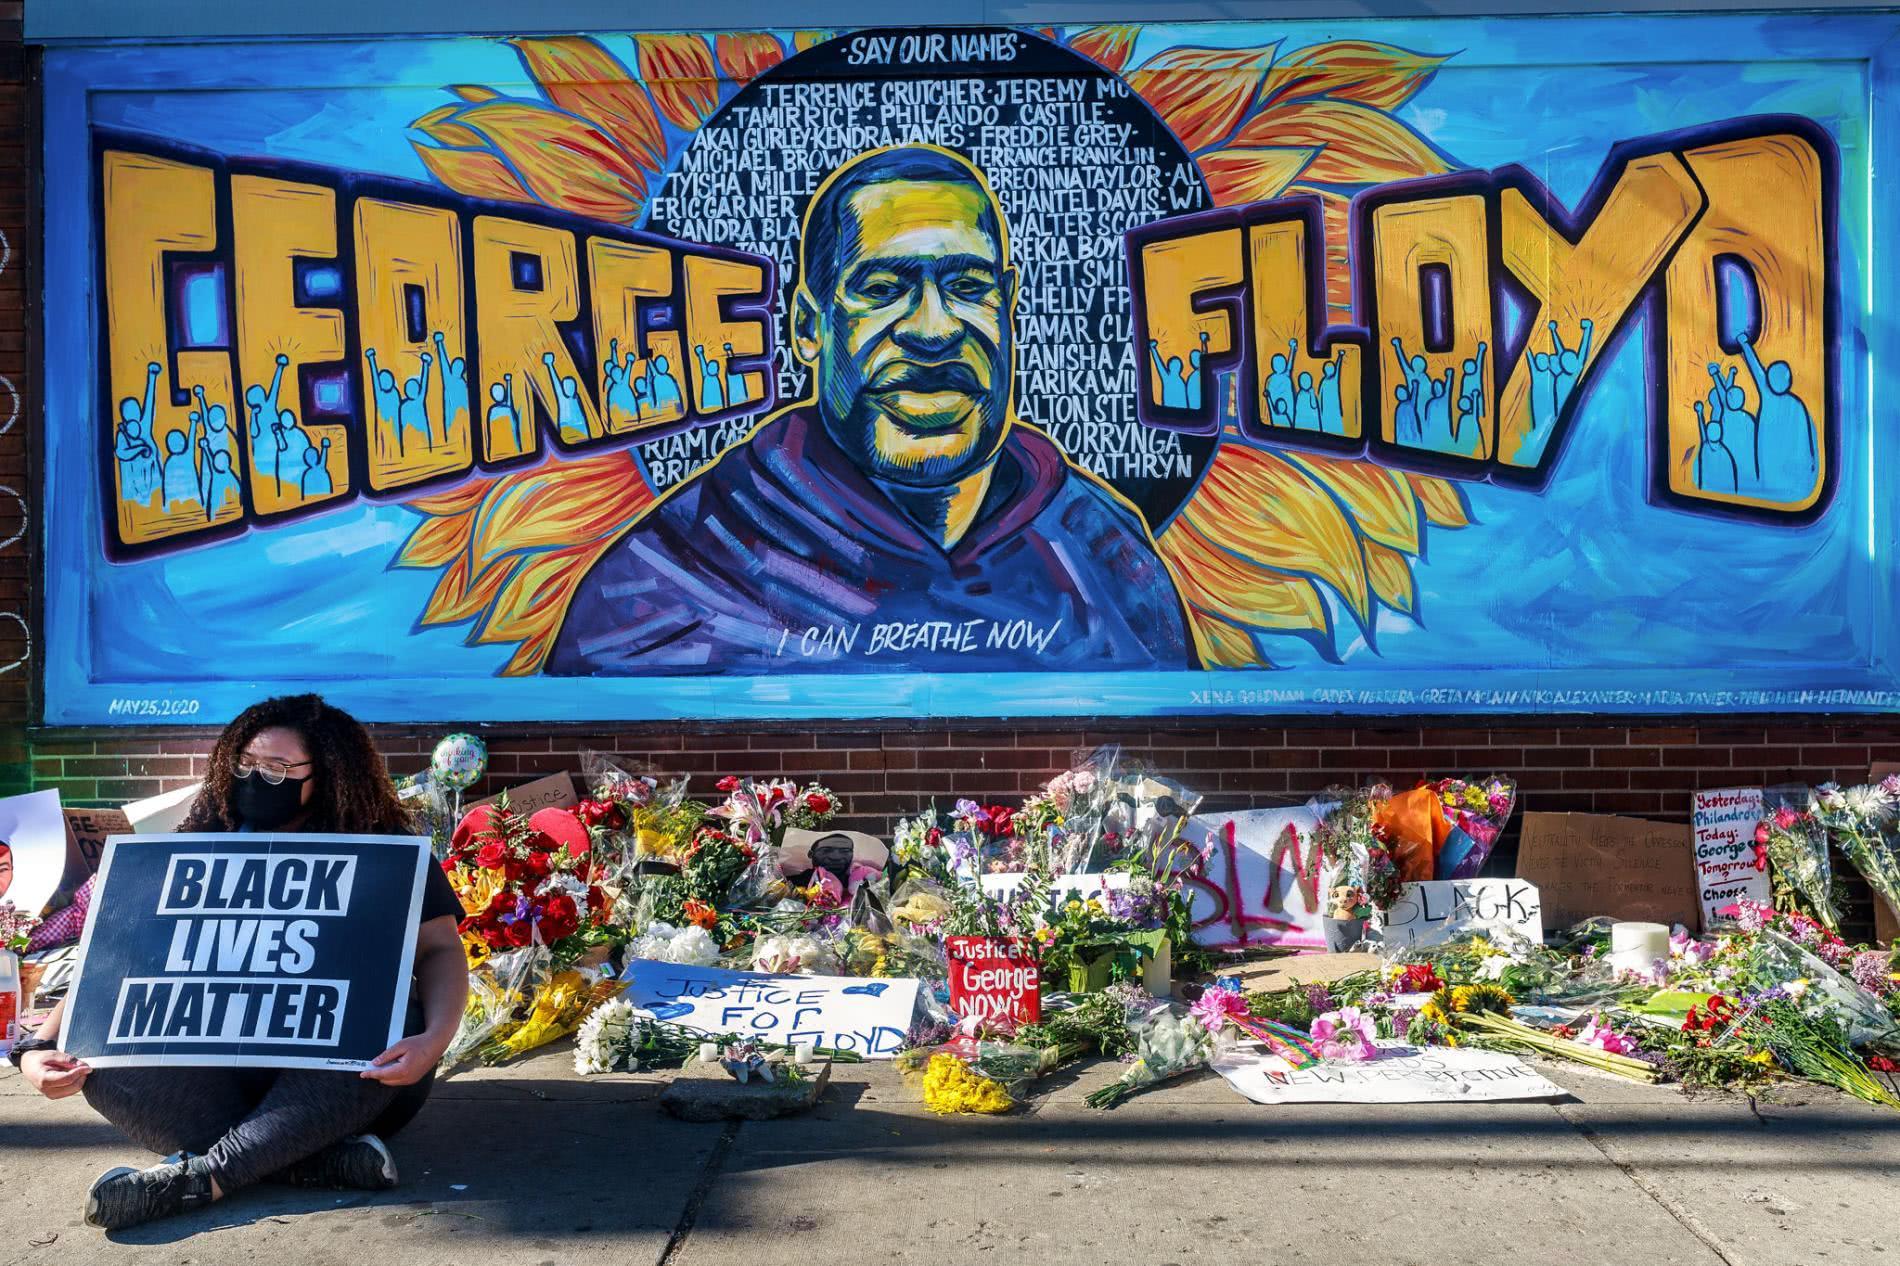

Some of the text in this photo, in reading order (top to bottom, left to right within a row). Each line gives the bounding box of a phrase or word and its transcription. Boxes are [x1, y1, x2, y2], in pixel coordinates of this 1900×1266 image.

[848, 32, 1017, 64] SAY OUR NAMES
[760, 82, 876, 107] TERRENCE
[881, 79, 984, 107] CRUTCHER
[994, 79, 1087, 105] JEREMY
[732, 102, 1106, 128] TAMIR RICE PHILANDO CASTILE
[693, 123, 1132, 150] AKAI GURLEY KENDRA JAMES FREDDIE GREY
[683, 151, 776, 173] MICHAEL
[971, 147, 1057, 167] TERRANCE
[1061, 147, 1155, 165] FRANKLIN
[667, 162, 1200, 198] TYISHA MILLE BREONNA TAYLOR AL
[652, 187, 1202, 220] ERIC GARNER SHANTEL DAVIS WI
[667, 219, 755, 242] SANDRA
[761, 216, 802, 242] BLA
[1003, 211, 1094, 238] WALTER
[1010, 237, 1075, 262] REKIA
[1081, 258, 1124, 287] SMI
[1017, 286, 1095, 314] SHELLY
[104, 132, 1827, 546] GEORGE FLOYD
[1014, 315, 1093, 344] JAMAR
[1015, 344, 1113, 370] TANISHA
[1016, 370, 1099, 395] TARIKA
[1017, 393, 1136, 424] ALTON STE
[1046, 422, 1182, 455] KORRYNGA
[1078, 453, 1193, 479] KATHRYN
[776, 616, 1063, 656] I CAN BREATHE NOW
[1421, 688, 1461, 704] GRETA
[1697, 828, 1739, 844] Today:
[1697, 840, 1746, 860] George
[163, 857, 350, 912] BLACK
[165, 919, 320, 974] LIVES
[953, 939, 1018, 959] Justice
[963, 961, 1038, 999] George
[115, 983, 340, 1040] MATTER
[959, 994, 1019, 1019] NOW!
[1263, 1069, 1345, 1087] NEW
